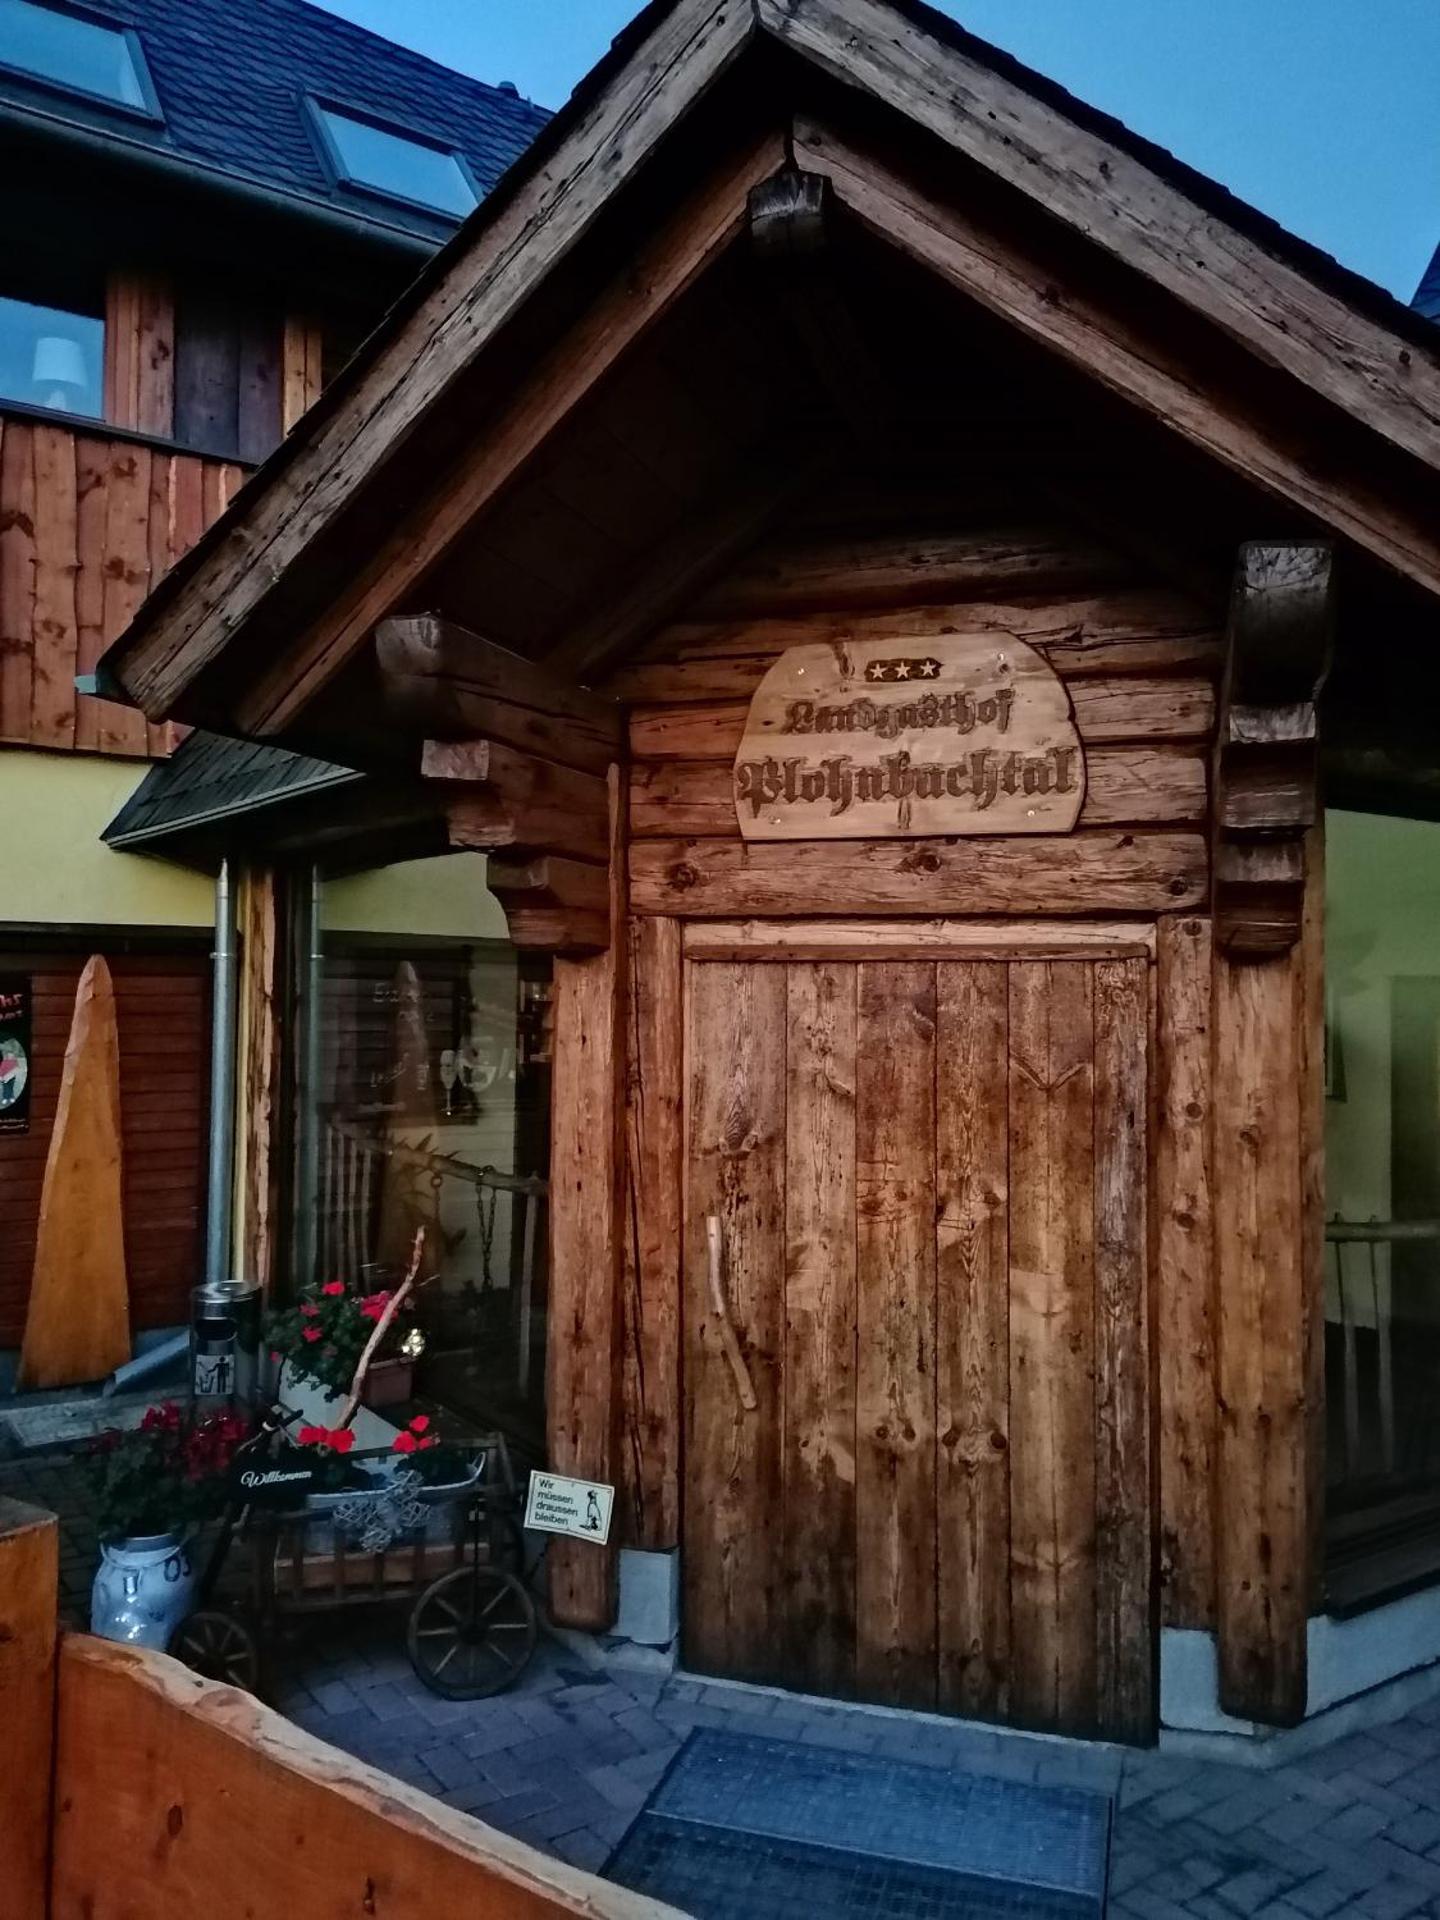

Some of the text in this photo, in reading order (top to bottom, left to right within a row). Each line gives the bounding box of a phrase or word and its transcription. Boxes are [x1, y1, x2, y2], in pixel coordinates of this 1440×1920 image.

[780, 688, 1016, 739] Landgasthof
[737, 745, 1079, 819] Plohnbachtal
[241, 1471, 312, 1488] Willkommen
[540, 1479, 554, 1489] Wir
[538, 1491, 573, 1504] müssen
[536, 1501, 578, 1516] draussen
[535, 1512, 569, 1525] bleiben
